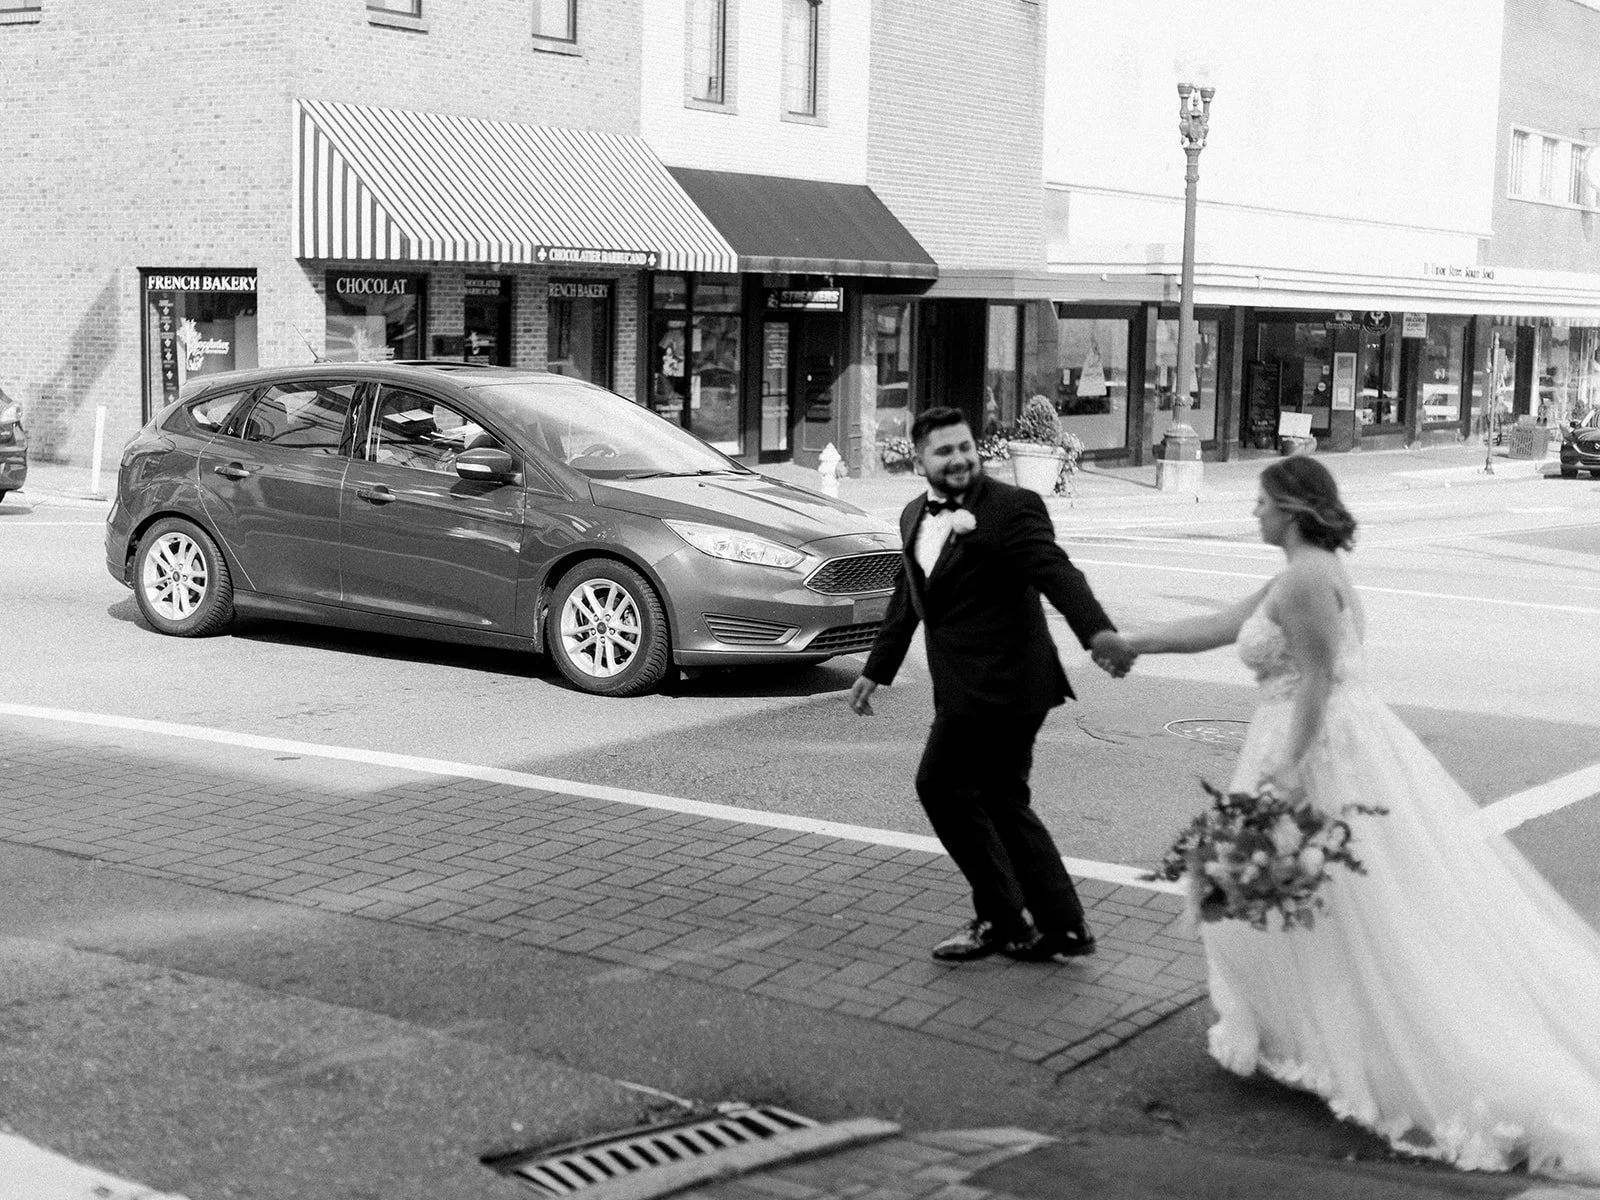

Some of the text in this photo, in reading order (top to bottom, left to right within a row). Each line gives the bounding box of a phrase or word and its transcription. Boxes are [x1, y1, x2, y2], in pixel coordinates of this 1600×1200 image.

[549, 248, 601, 263] CHOCOLATIER
[148, 275, 258, 291] FRENCH BAKERY
[336, 277, 408, 295] CHOCOLAT
[464, 280, 501, 288] HOCOLATIER
[547, 282, 610, 298] RENCH BAKERY
[781, 290, 840, 303] STREAKERS
